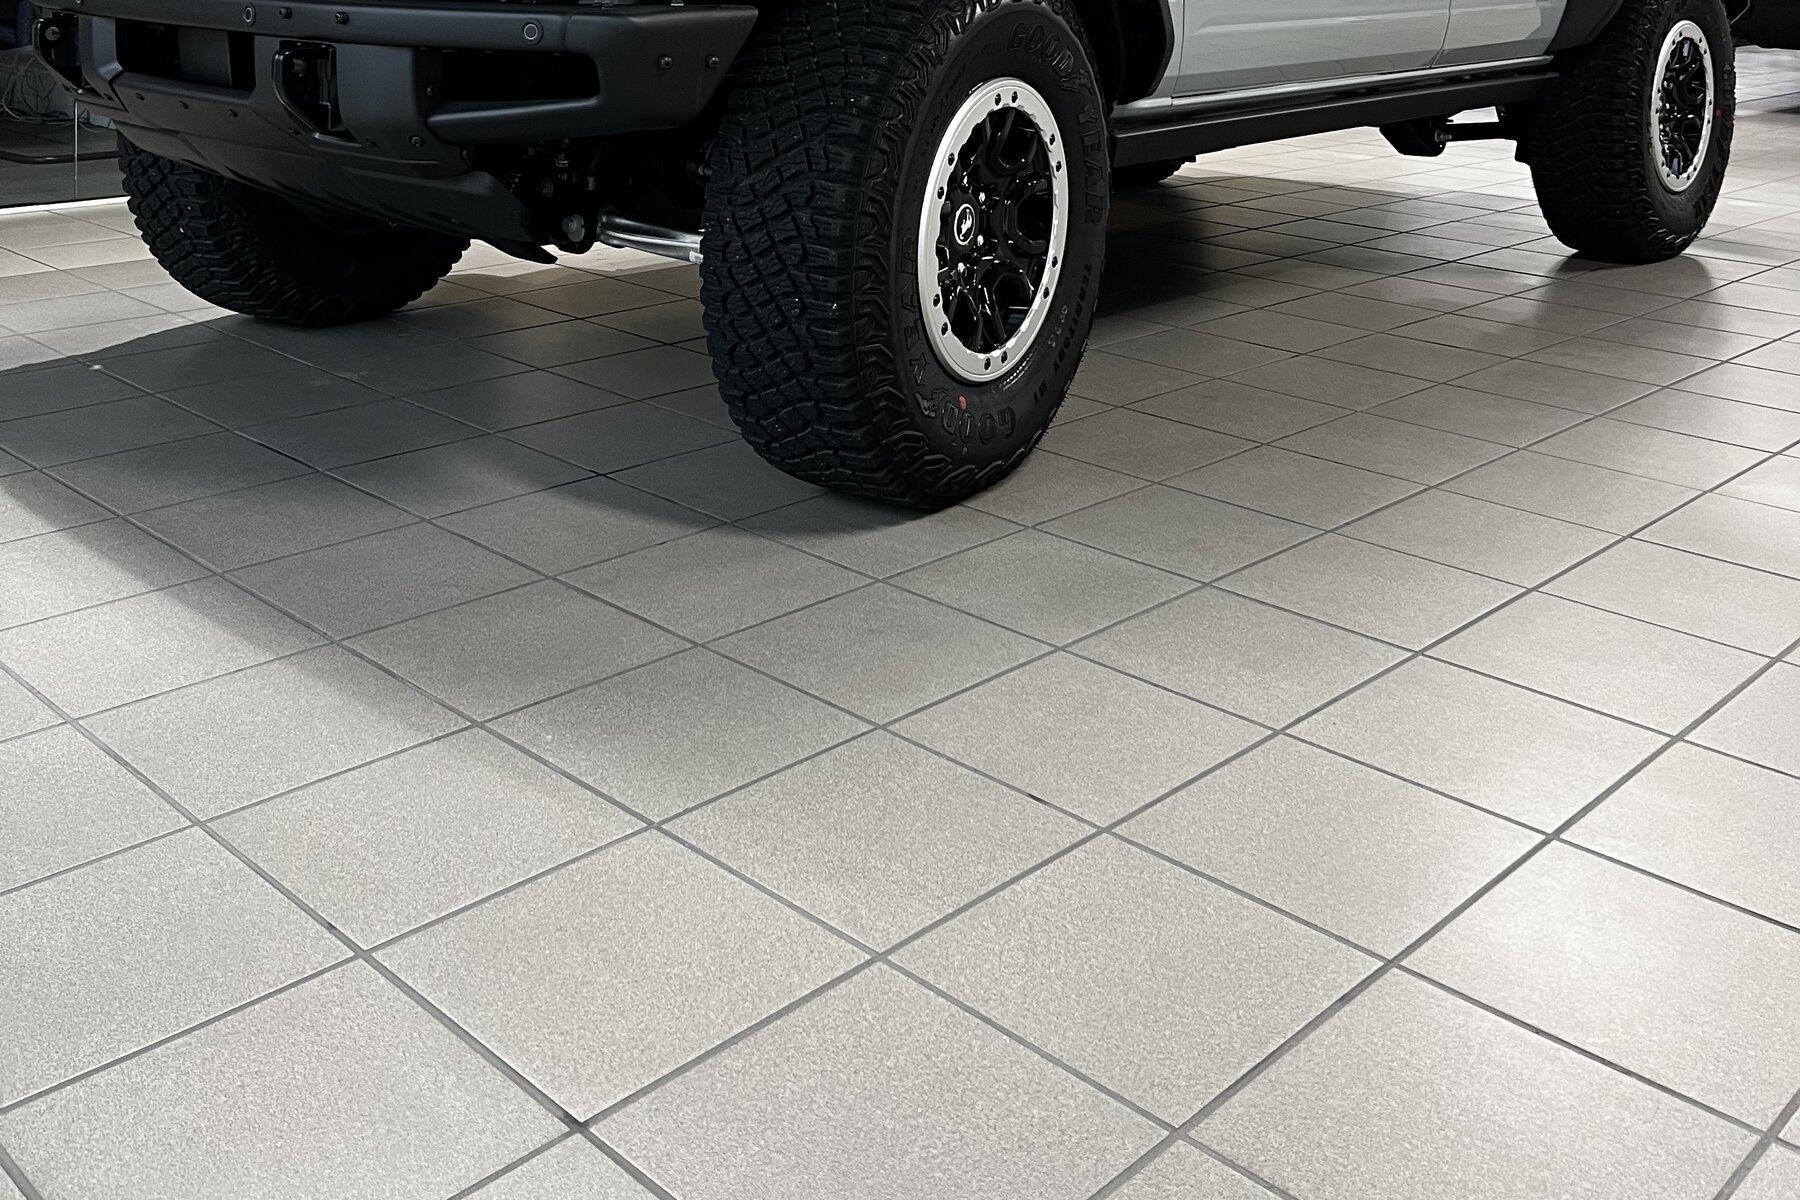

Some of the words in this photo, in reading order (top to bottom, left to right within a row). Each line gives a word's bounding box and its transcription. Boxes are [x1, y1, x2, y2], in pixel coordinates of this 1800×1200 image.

[1007, 22, 1104, 226] GOODYEAR
[900, 236, 1015, 445] GOODYEAR
[1053, 263, 1091, 374] TERRITORY
